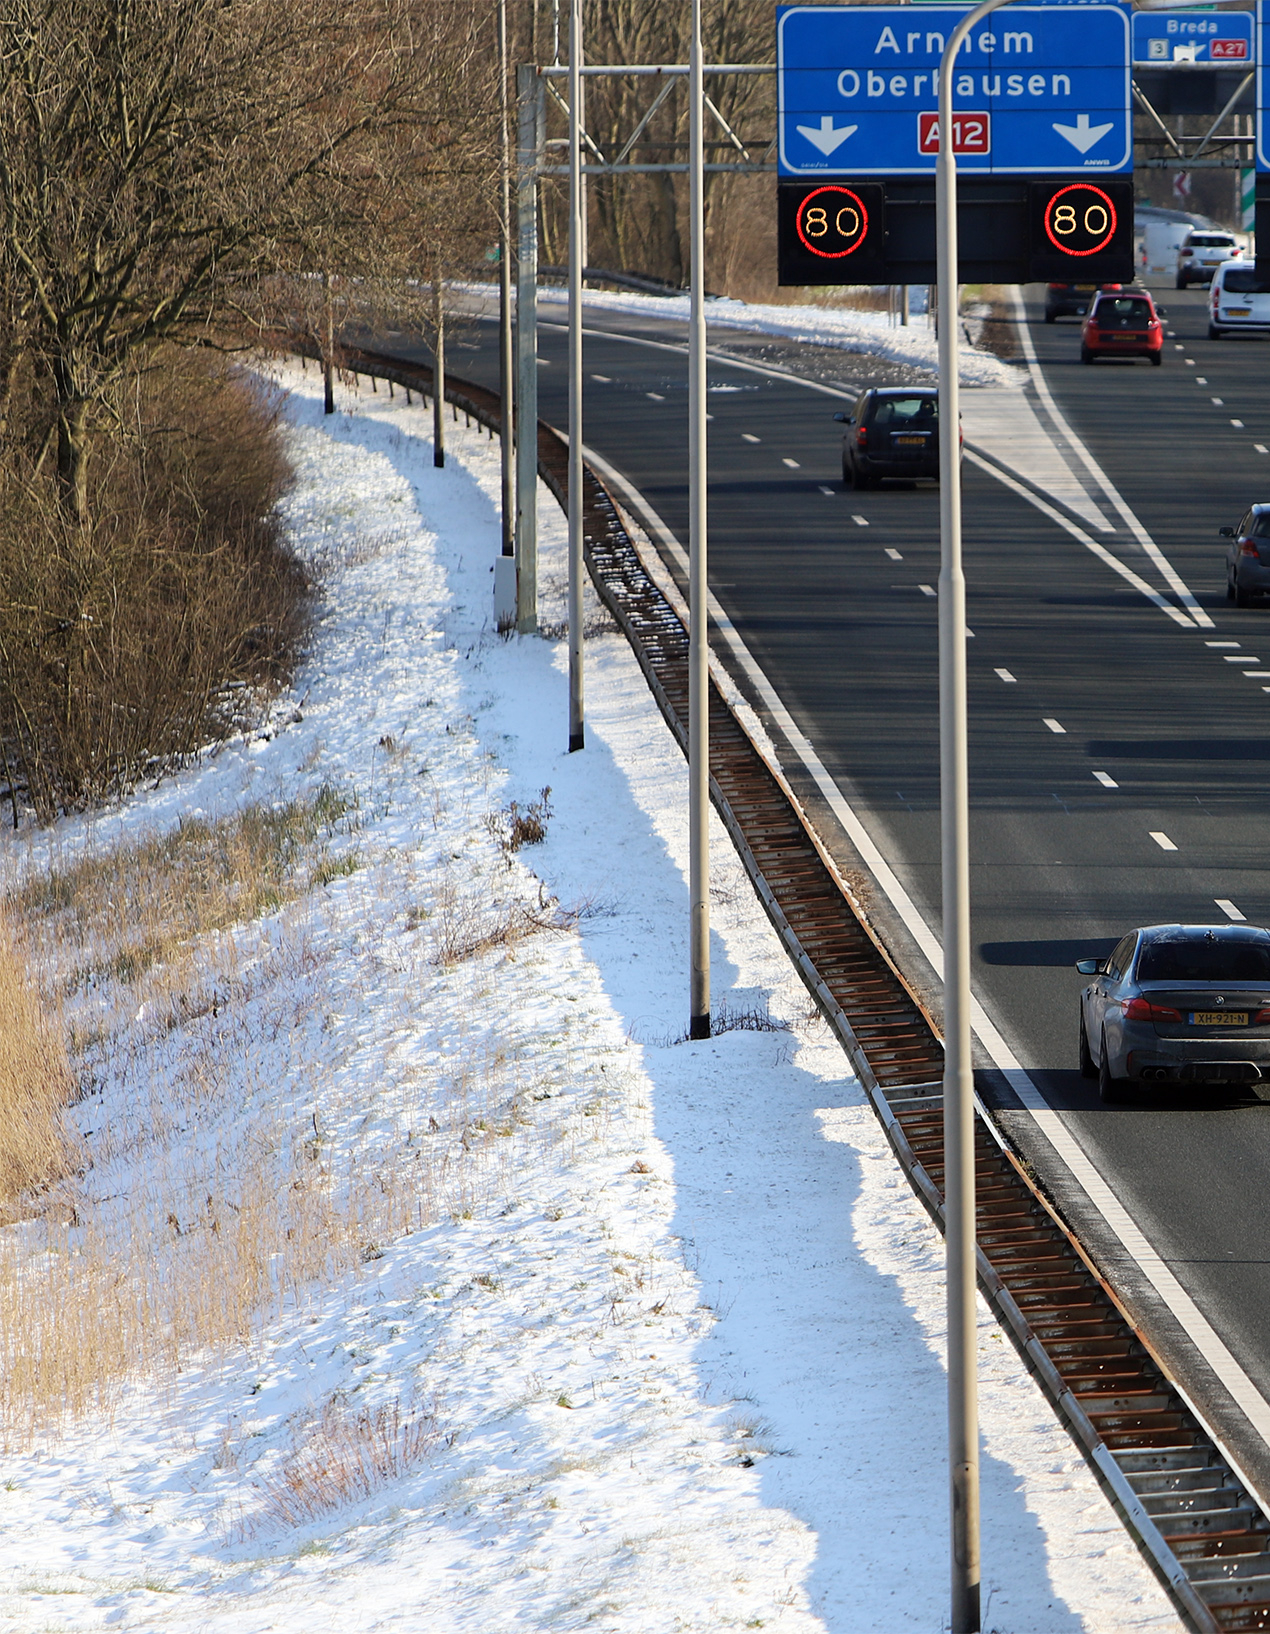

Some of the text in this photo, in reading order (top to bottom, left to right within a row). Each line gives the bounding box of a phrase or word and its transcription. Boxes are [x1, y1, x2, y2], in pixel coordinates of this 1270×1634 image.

[1167, 20, 1218, 33] Breda
[1154, 43, 1164, 54] 3
[1213, 43, 1245, 55] A27
[924, 121, 983, 146] A12
[806, 207, 859, 237] 80
[1054, 205, 1108, 235] 80
[1198, 1014, 1245, 1024] XH-921-N
